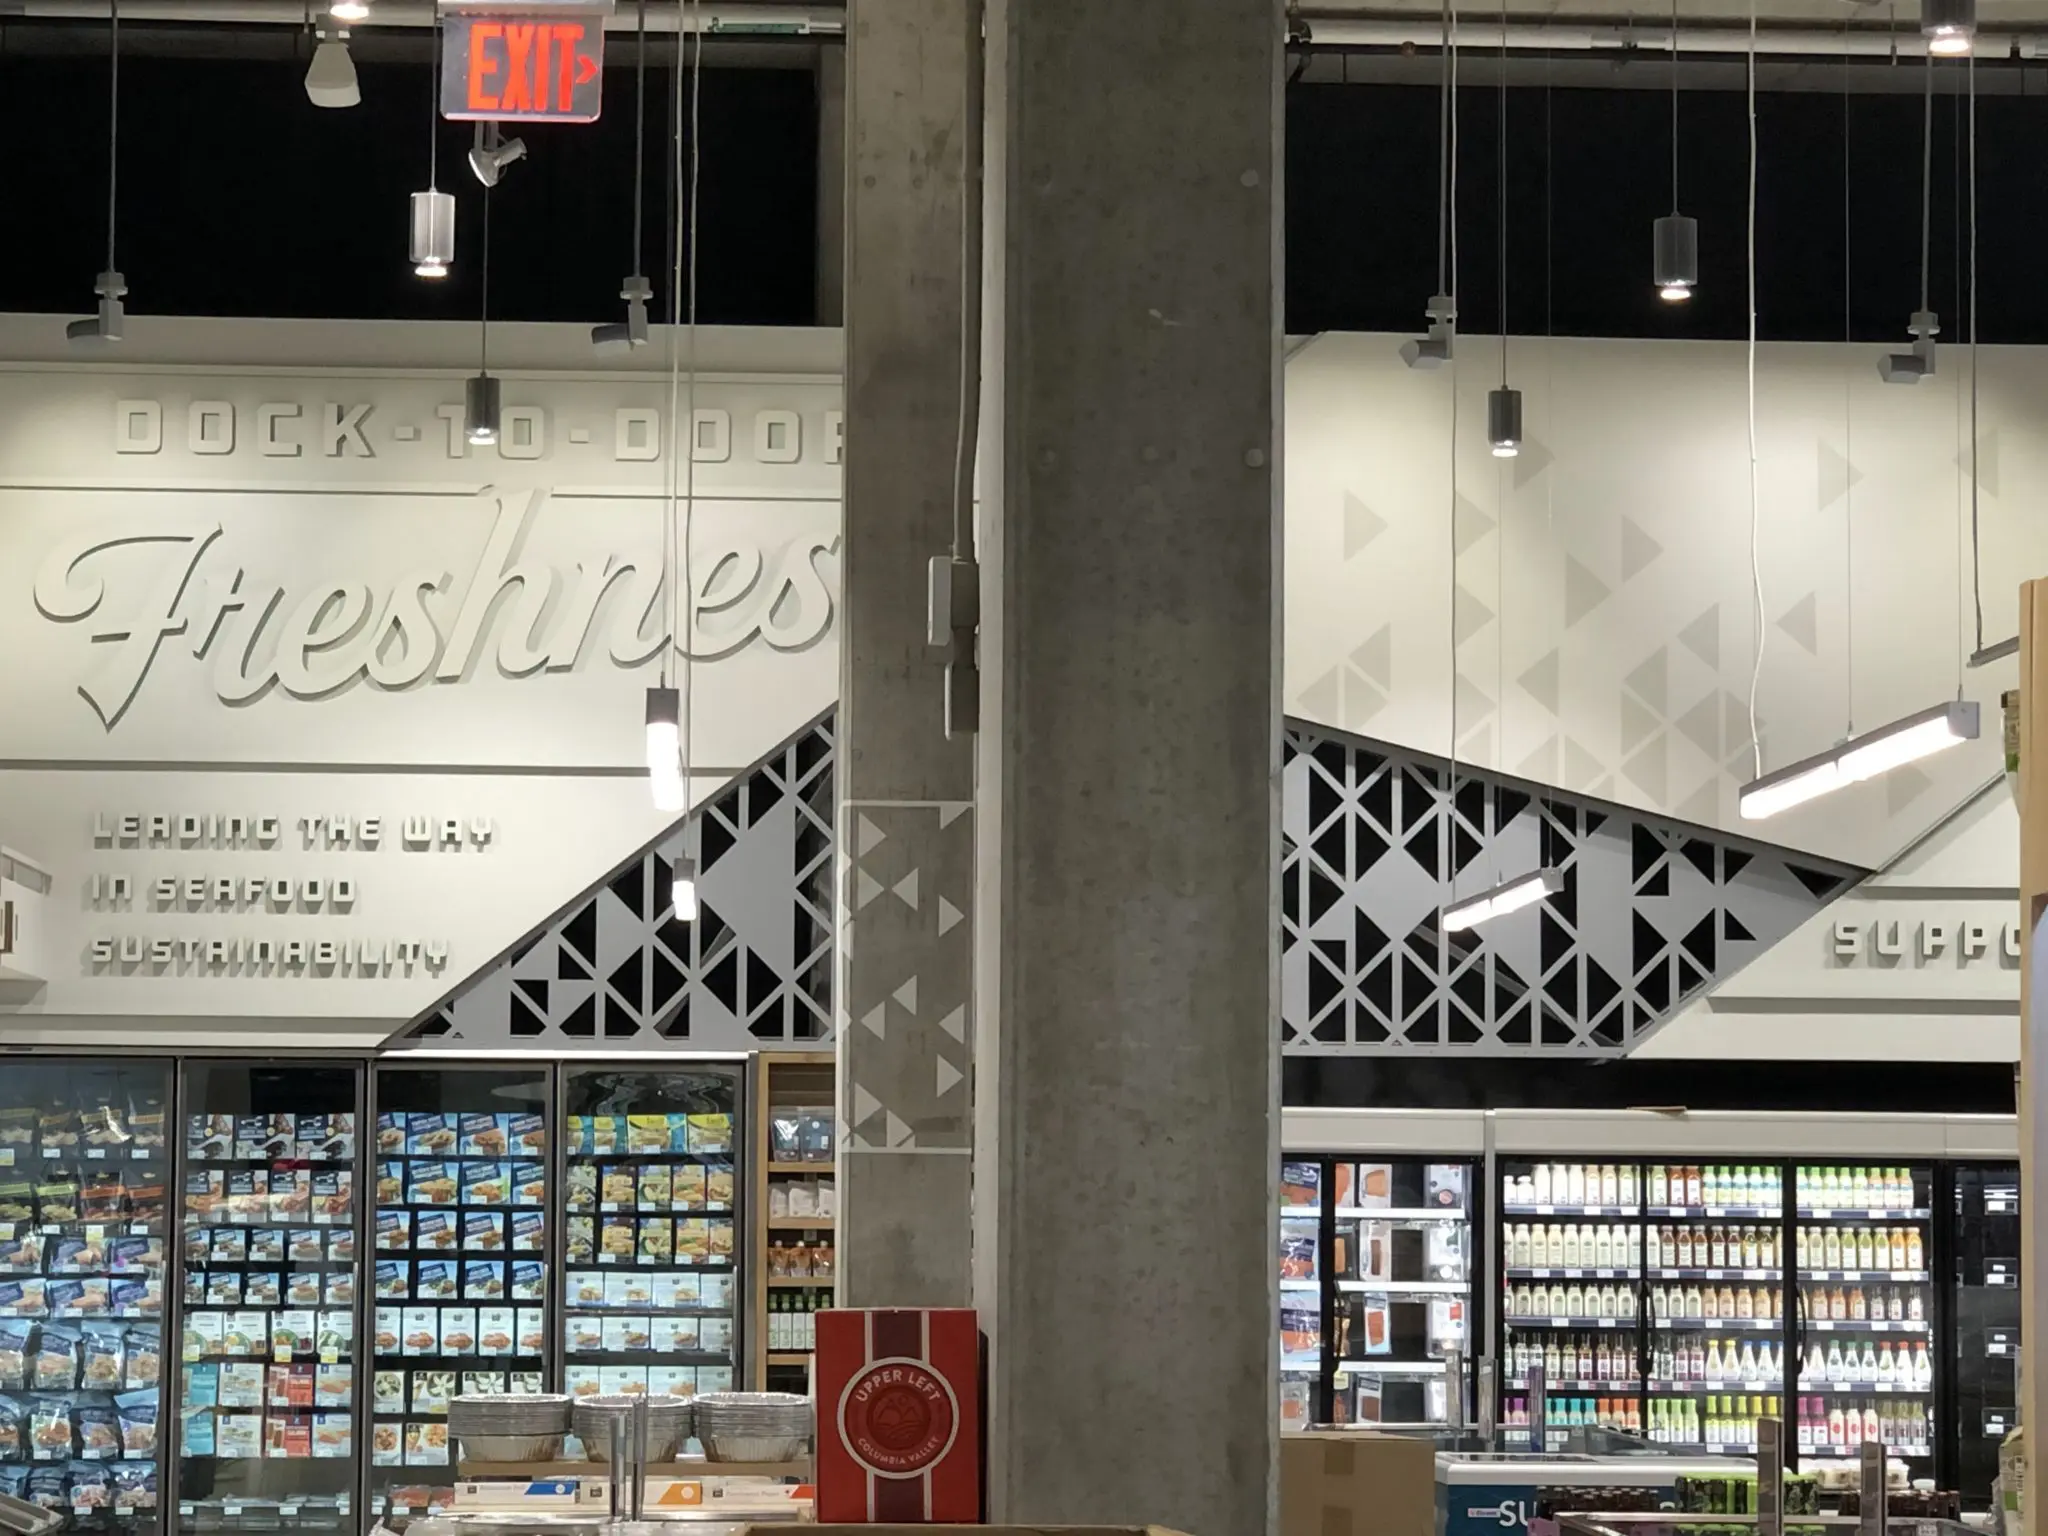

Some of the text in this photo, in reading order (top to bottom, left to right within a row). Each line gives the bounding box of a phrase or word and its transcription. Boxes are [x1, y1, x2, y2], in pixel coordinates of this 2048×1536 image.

[468, 22, 585, 112] EXIT
[93, 812, 492, 843] LEADING THE WAY
[91, 873, 356, 902] IN SEAFOOD
[91, 938, 448, 966] SUSTAINABILITY
[855, 1369, 941, 1402] UPPER LEFT
[857, 1435, 940, 1465] COLUMBIA VALLEY
